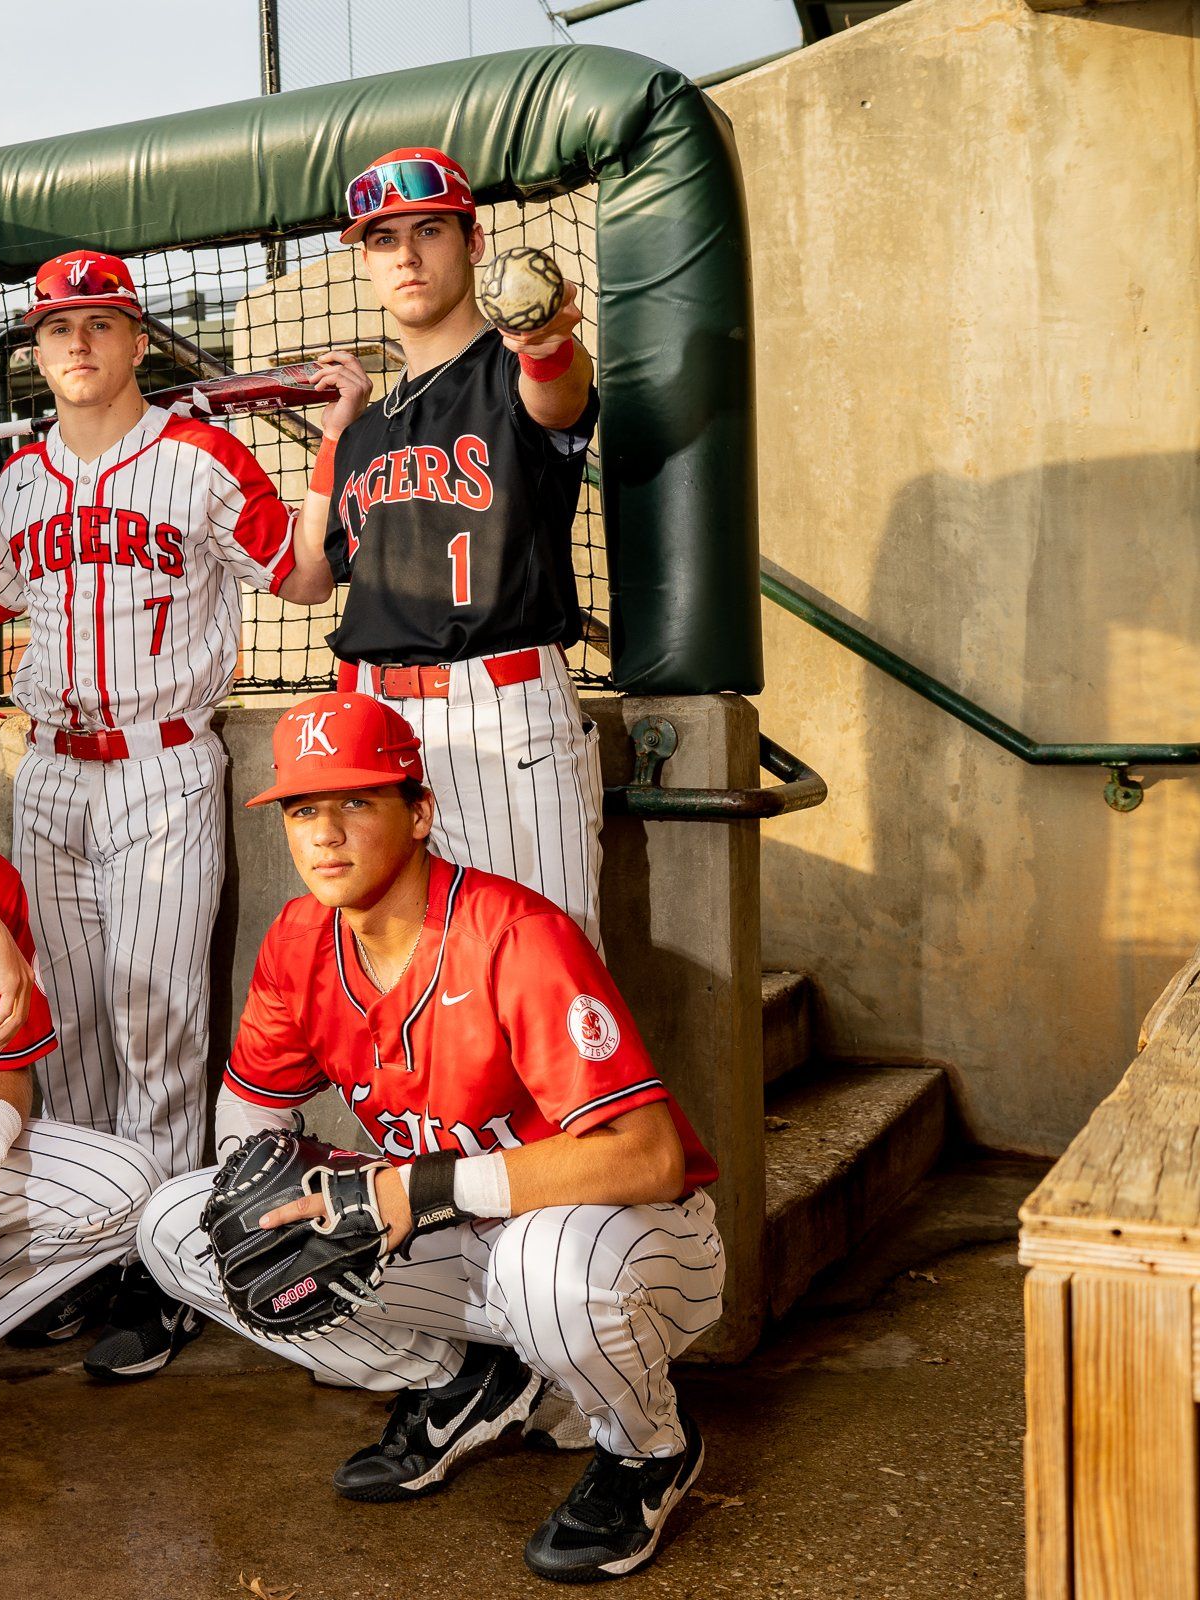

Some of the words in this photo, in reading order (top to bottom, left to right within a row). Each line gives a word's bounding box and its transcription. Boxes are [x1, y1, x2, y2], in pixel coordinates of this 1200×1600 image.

[448, 531, 471, 607] 1
[143, 594, 174, 656] 7
[296, 711, 338, 761] K
[584, 1036, 616, 1057] TIGERS
[271, 1276, 318, 1314] A2000
